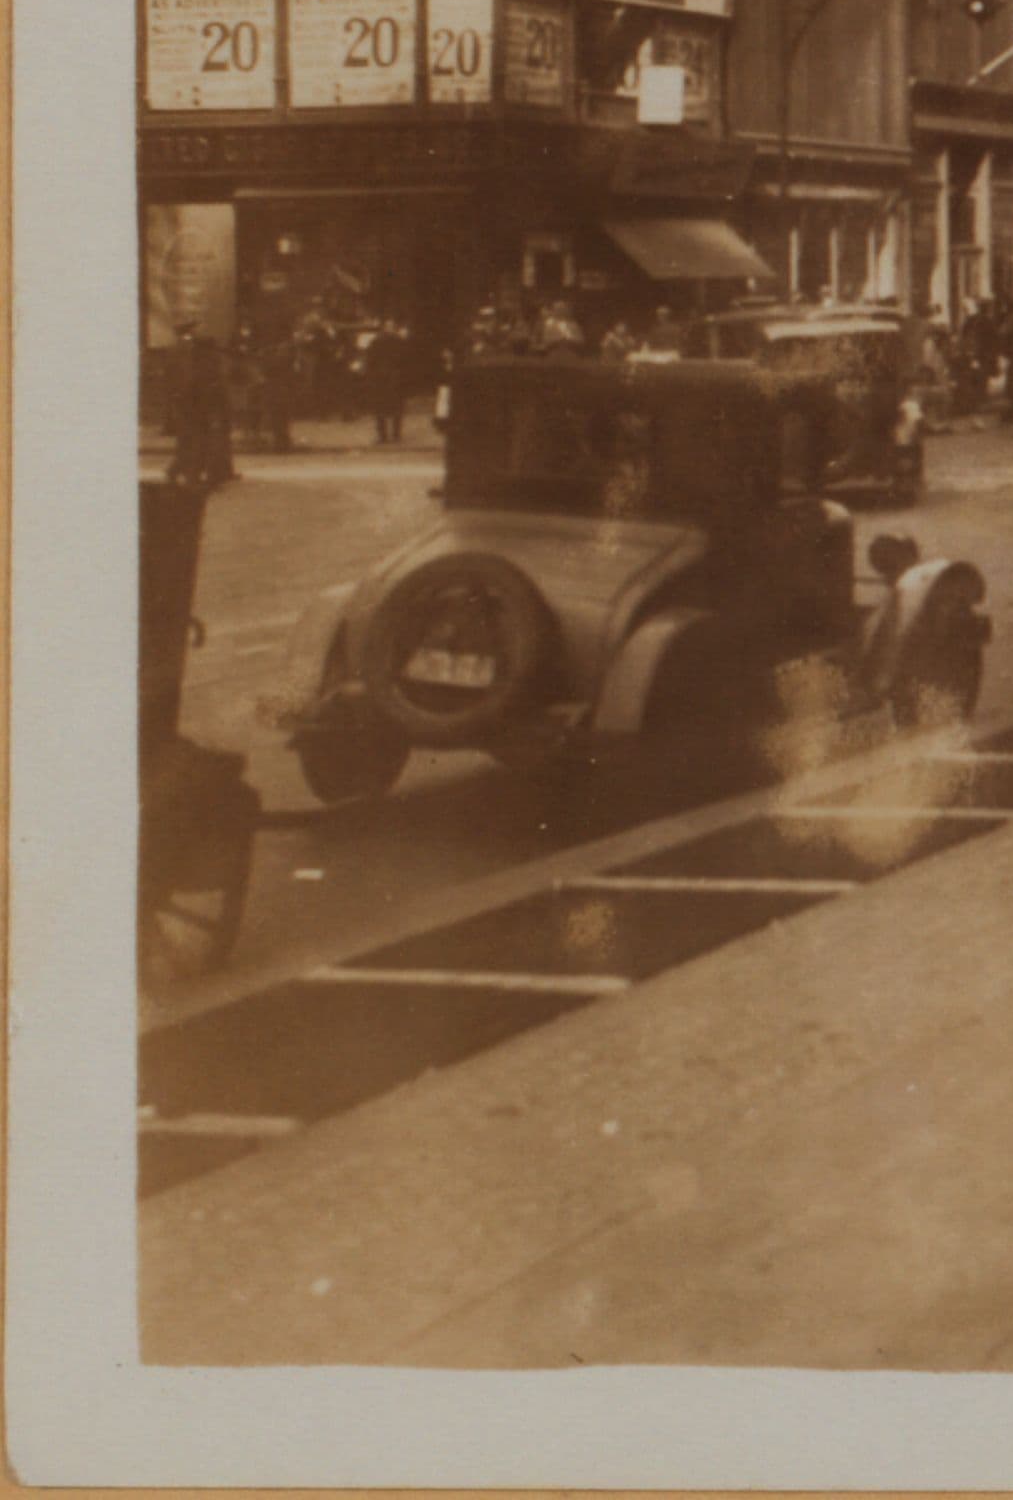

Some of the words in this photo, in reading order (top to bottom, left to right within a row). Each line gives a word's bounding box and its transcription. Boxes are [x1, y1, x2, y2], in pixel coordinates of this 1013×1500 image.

[201, 20, 259, 73] 20
[342, 15, 400, 68] 20
[431, 27, 482, 77] 20
